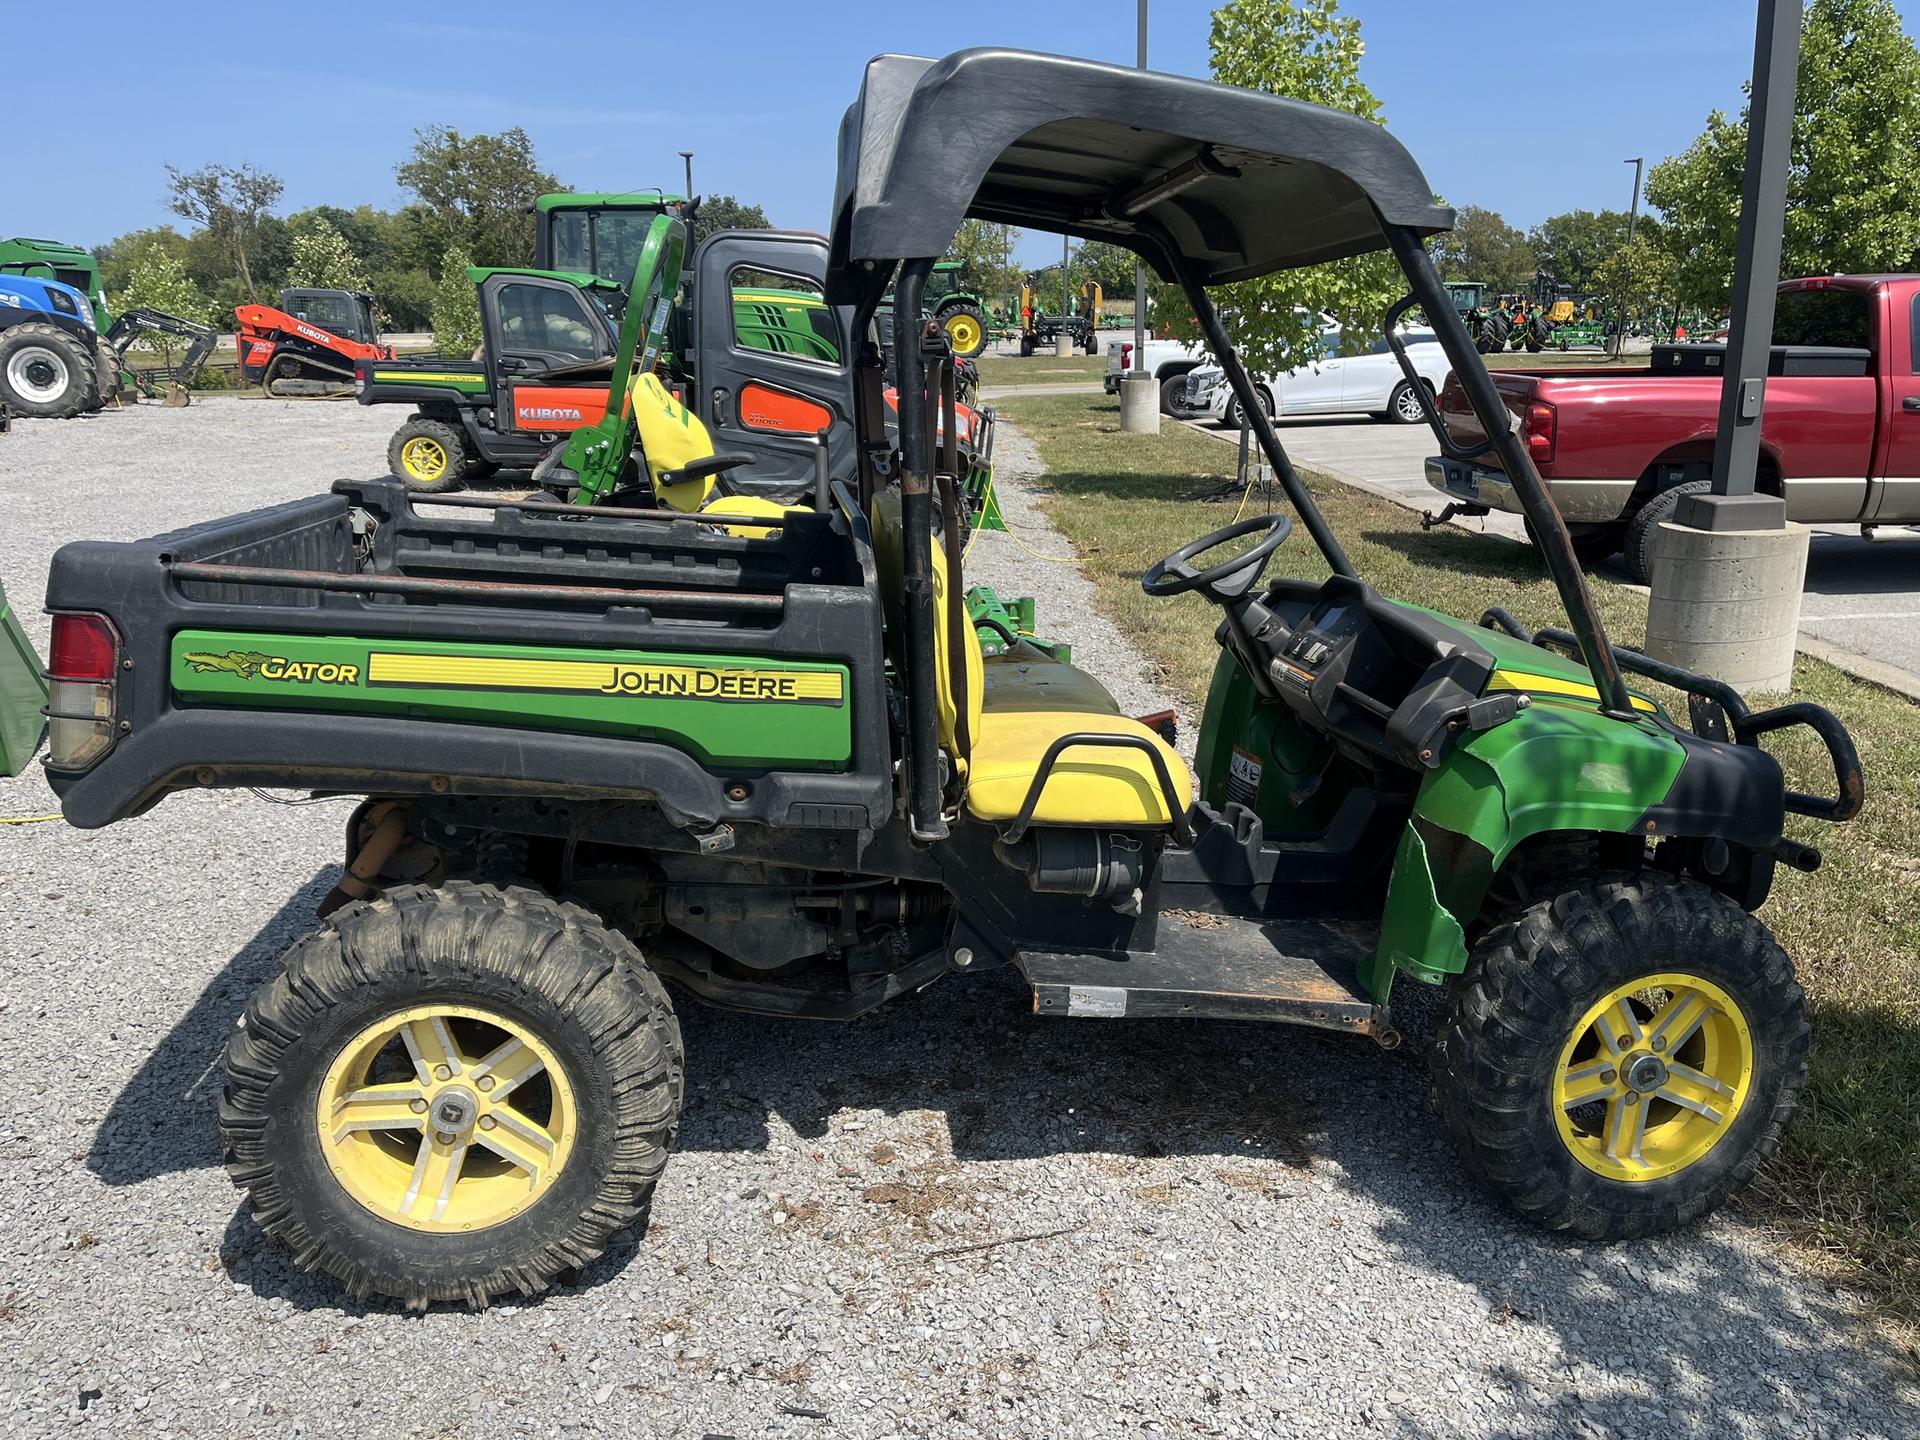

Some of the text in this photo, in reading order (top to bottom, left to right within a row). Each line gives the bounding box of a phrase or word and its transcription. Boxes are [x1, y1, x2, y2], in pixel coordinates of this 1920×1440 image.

[296, 324, 330, 344] KUBOTA
[519, 407, 582, 420] KUBOTA
[260, 657, 359, 684] GATOR
[601, 666, 796, 697] JOHN DEERE
